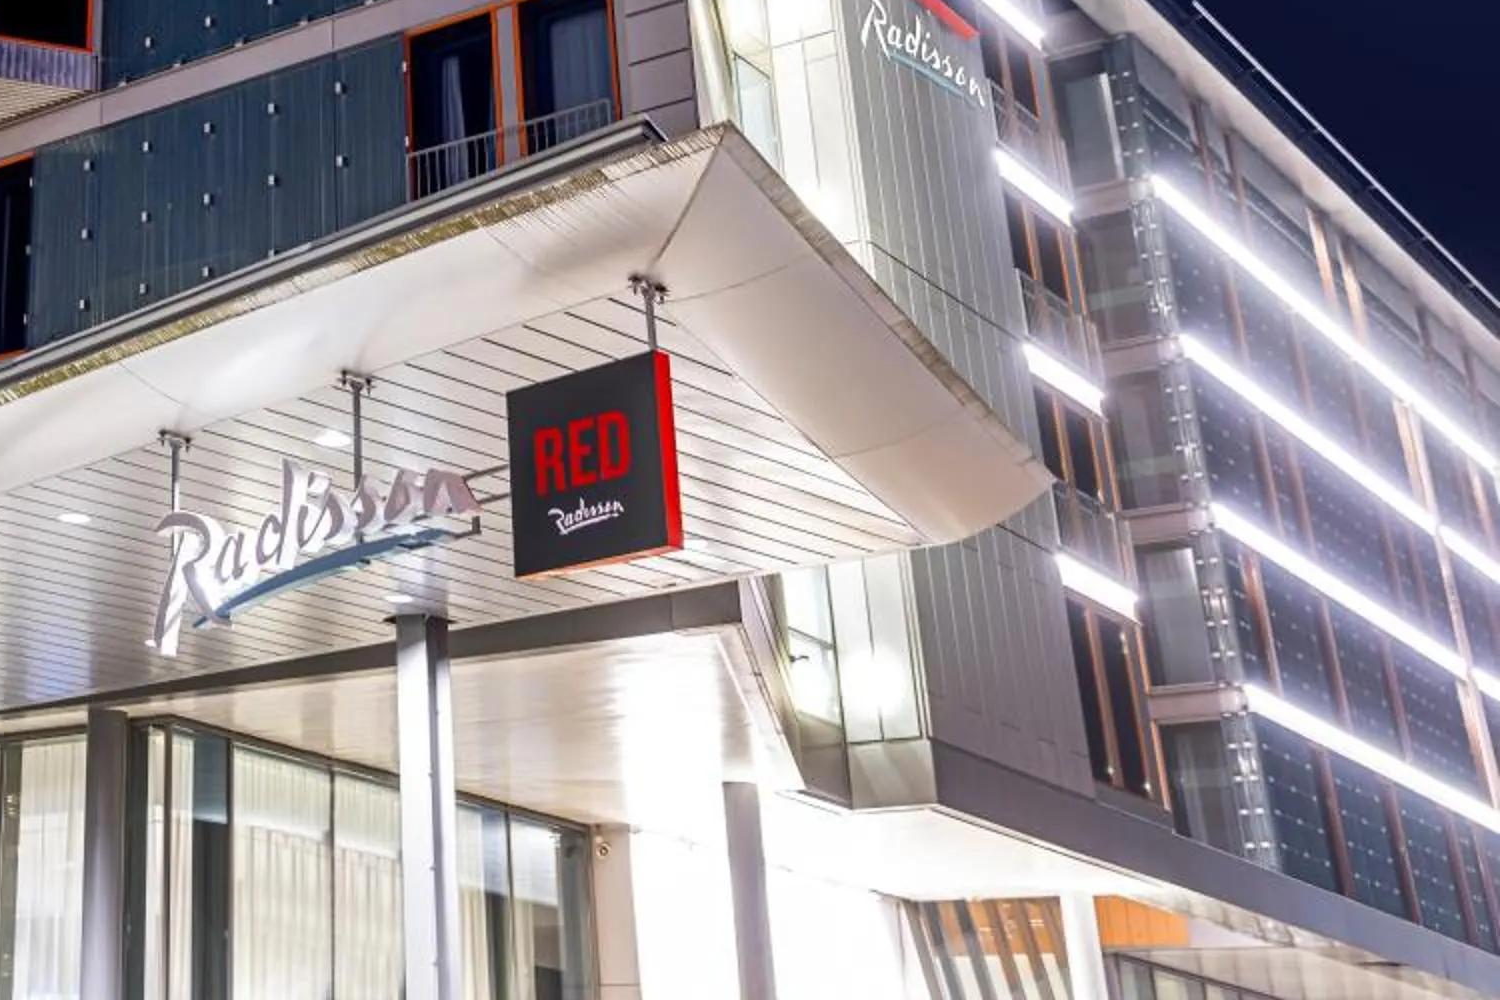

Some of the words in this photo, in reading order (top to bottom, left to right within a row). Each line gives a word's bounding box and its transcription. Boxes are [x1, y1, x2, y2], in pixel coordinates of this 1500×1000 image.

[534, 411, 631, 496] RED
[144, 457, 484, 657] Radisson
[547, 497, 625, 535] Radisson
